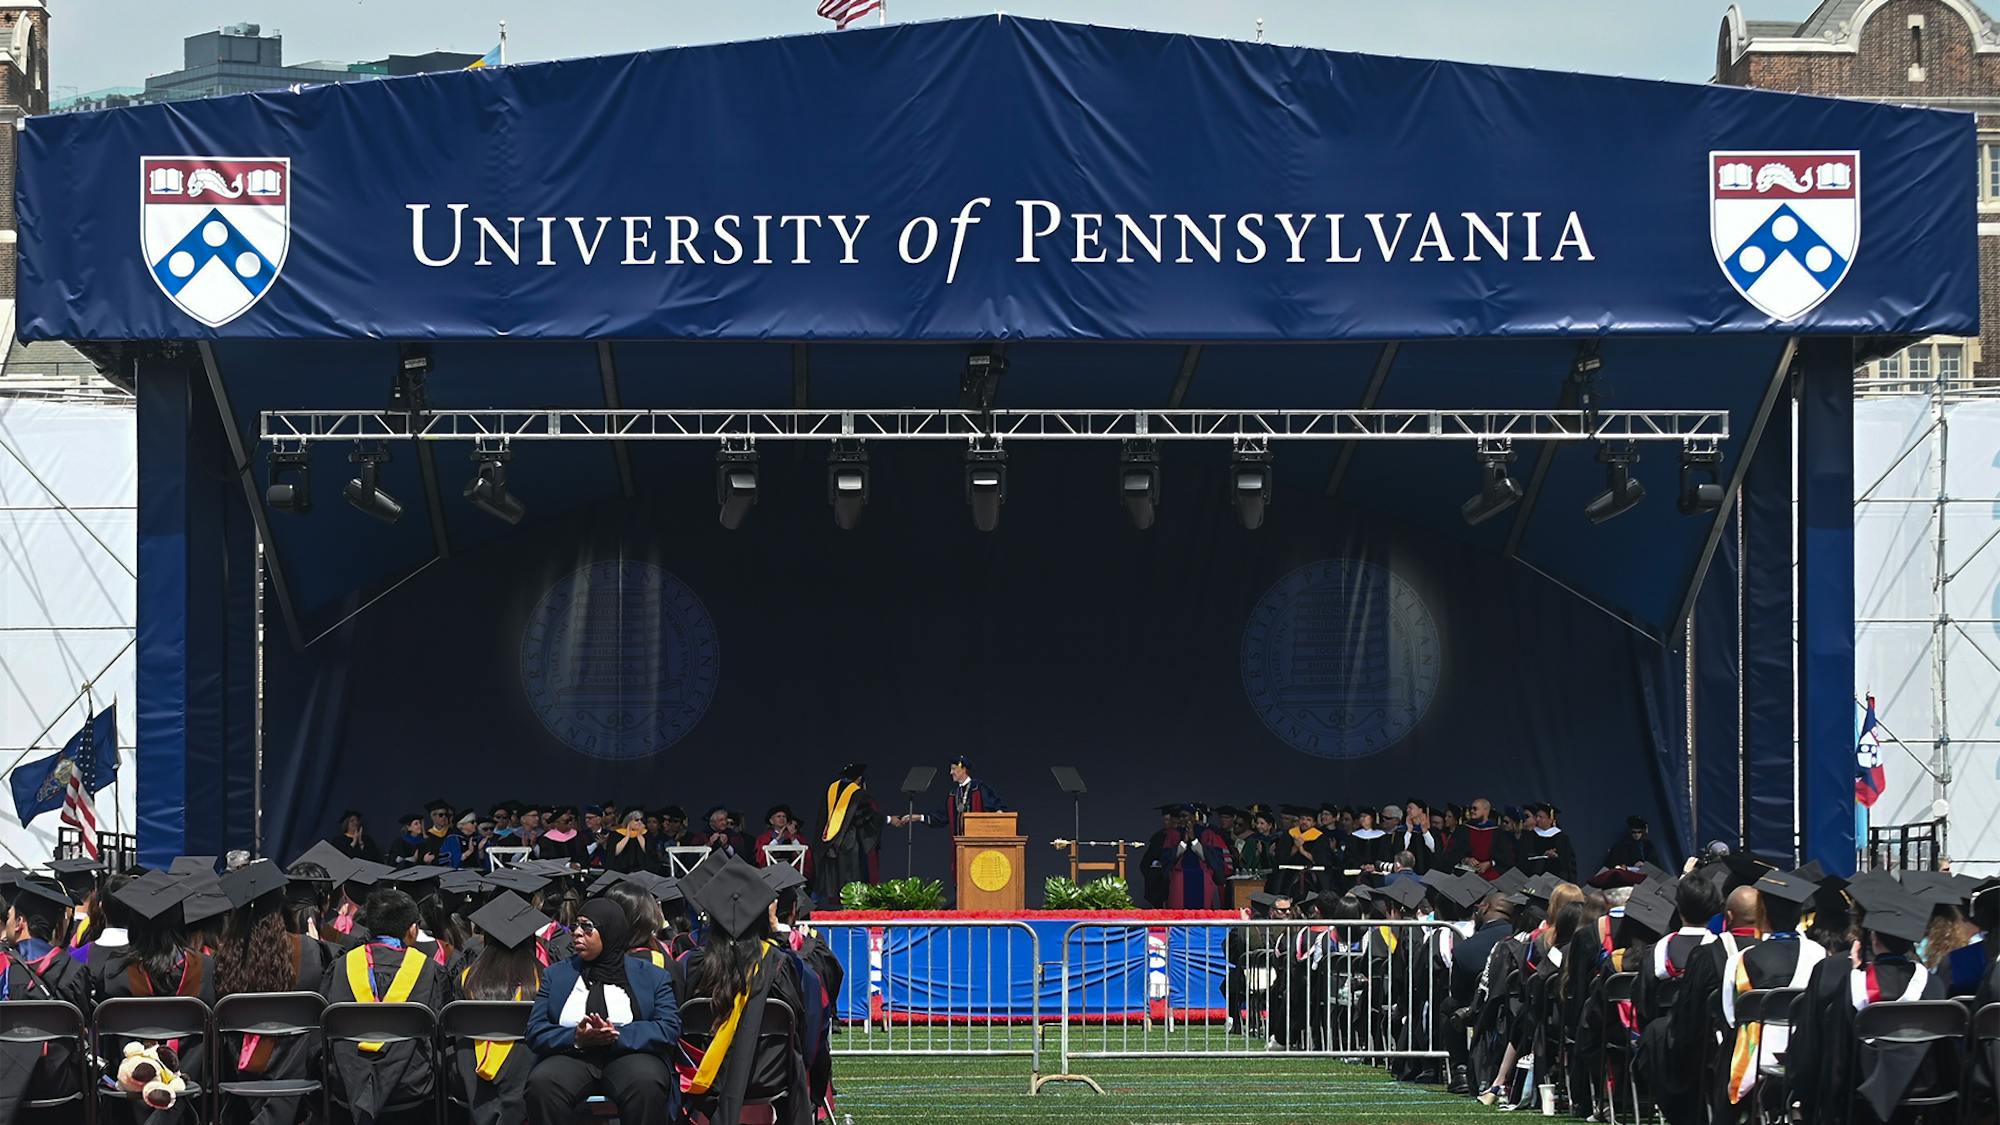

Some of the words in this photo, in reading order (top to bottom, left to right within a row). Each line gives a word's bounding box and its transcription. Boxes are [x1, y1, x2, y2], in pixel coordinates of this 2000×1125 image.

[405, 203, 871, 267] UNIVERSITY
[898, 197, 991, 284] of
[1015, 200, 1596, 263] PENNSYLVANIA
